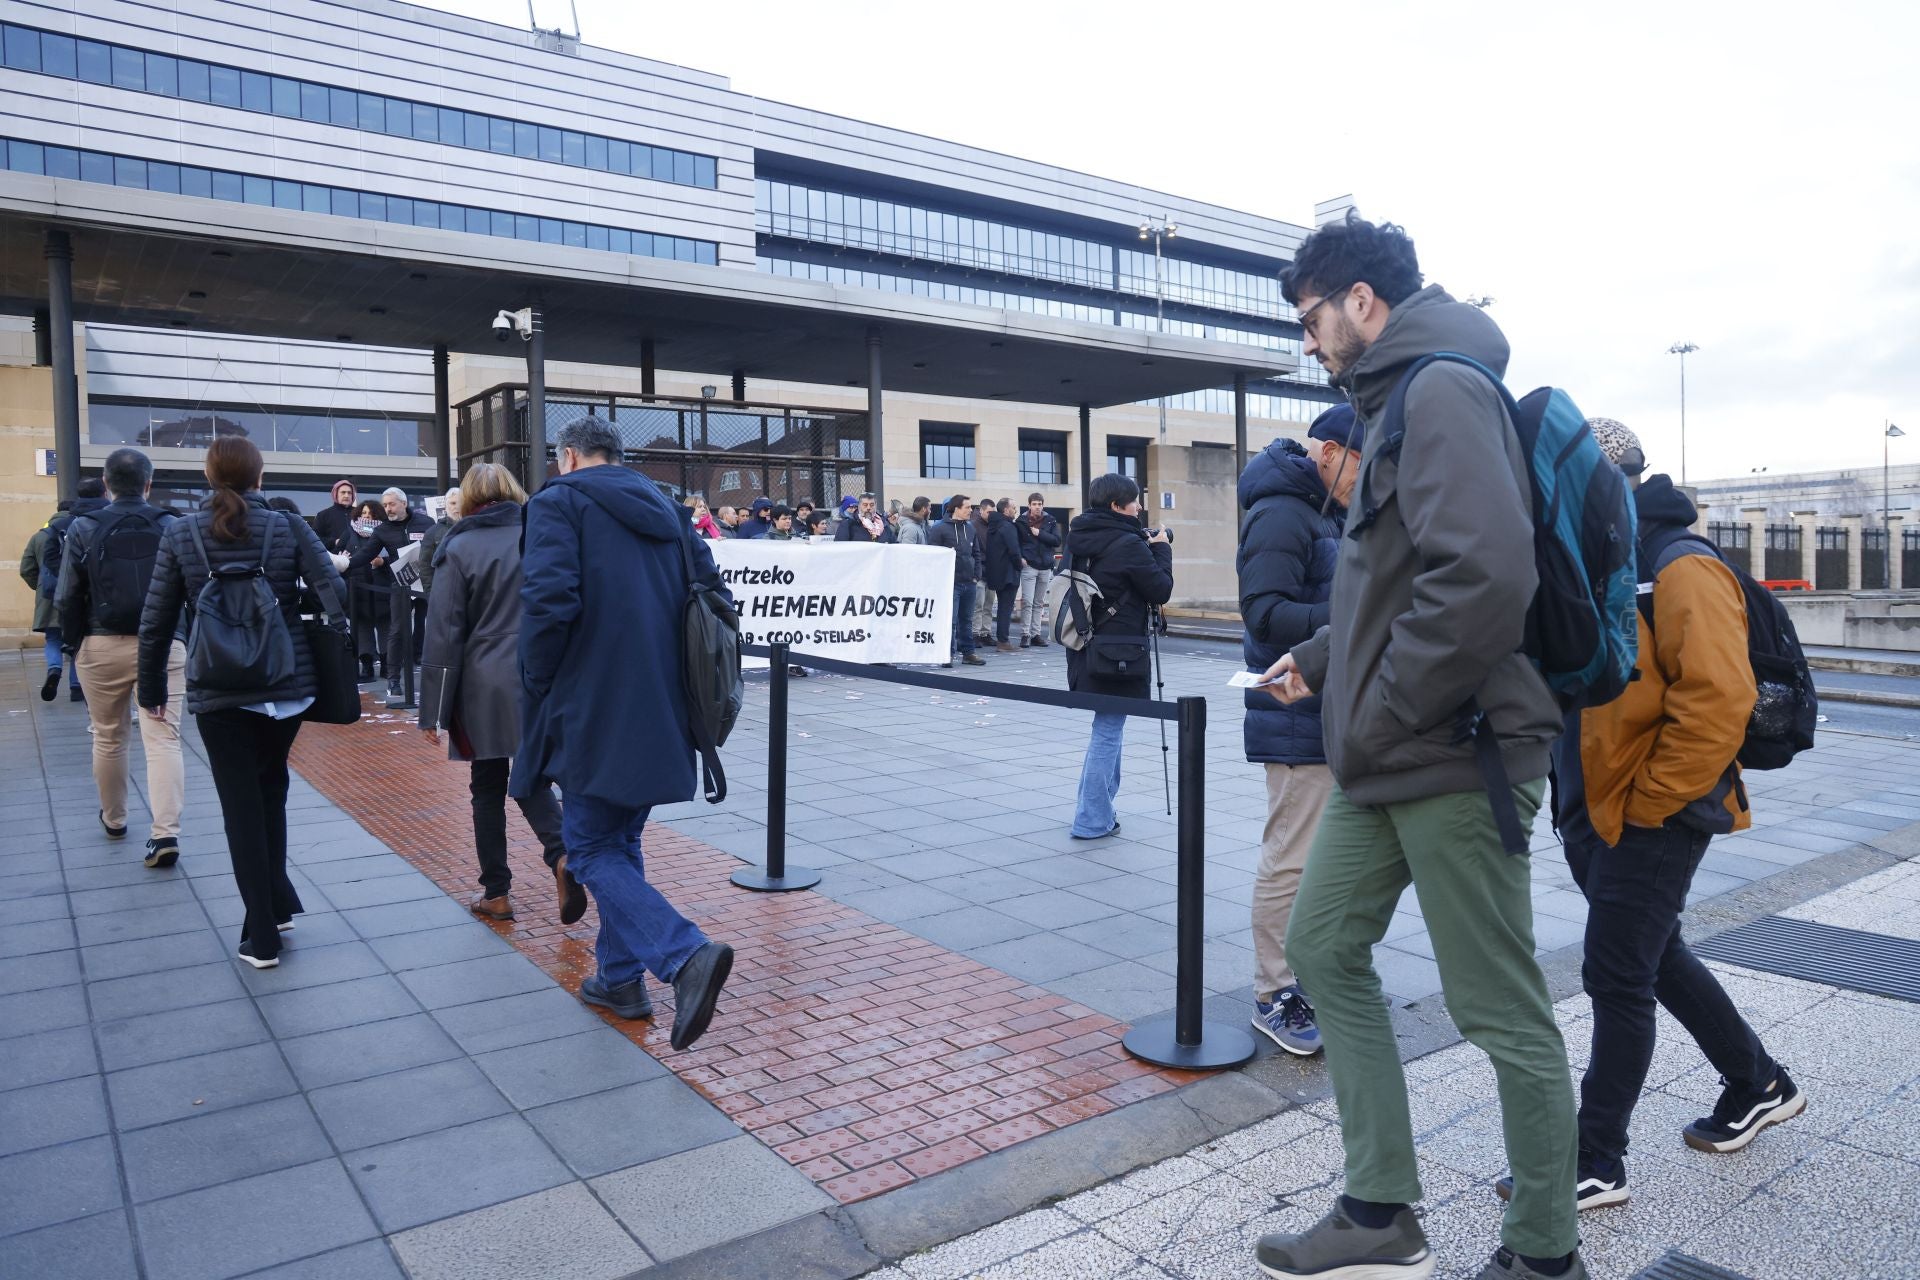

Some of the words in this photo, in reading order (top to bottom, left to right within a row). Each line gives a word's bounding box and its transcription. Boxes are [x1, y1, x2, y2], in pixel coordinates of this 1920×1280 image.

[717, 564, 795, 585] artzeko
[751, 595, 837, 619] HEMEN
[841, 595, 935, 619] ADOSTU!
[739, 632, 755, 645] AB
[766, 630, 804, 645] CCOO
[813, 629, 866, 644] STEILAS
[914, 631, 935, 644] ESK
